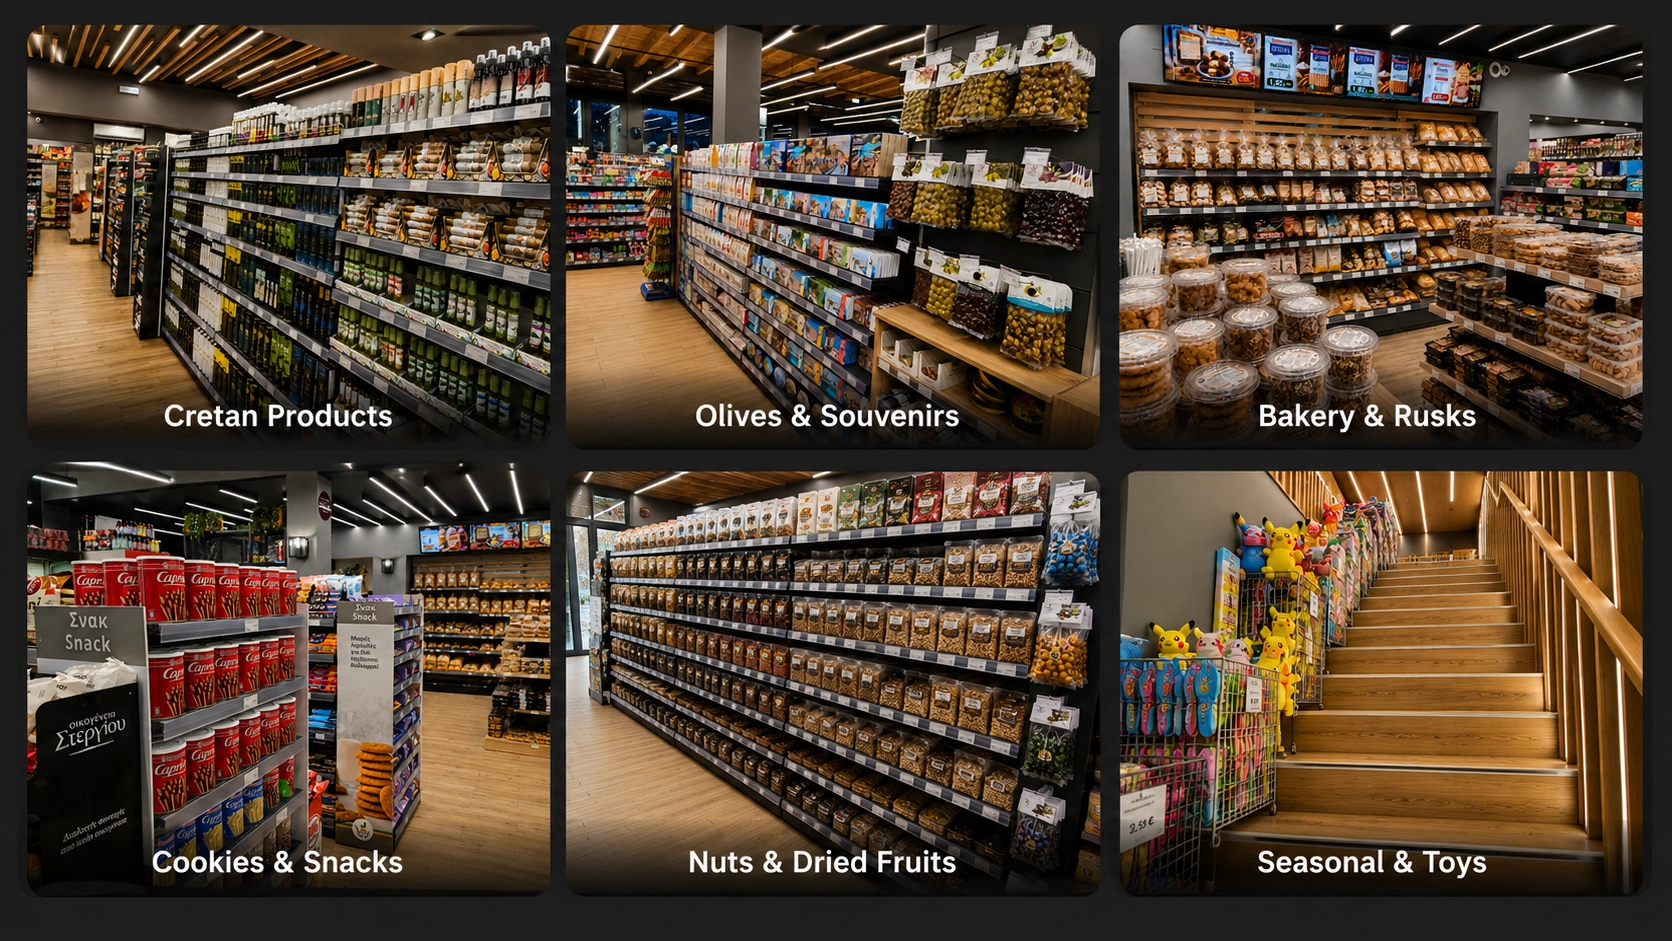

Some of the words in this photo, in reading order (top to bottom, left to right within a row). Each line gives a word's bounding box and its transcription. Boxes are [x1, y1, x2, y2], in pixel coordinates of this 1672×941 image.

[69, 611, 109, 629] Σνακ
[65, 634, 111, 653] Snack
[55, 718, 126, 752] Στεργίου
